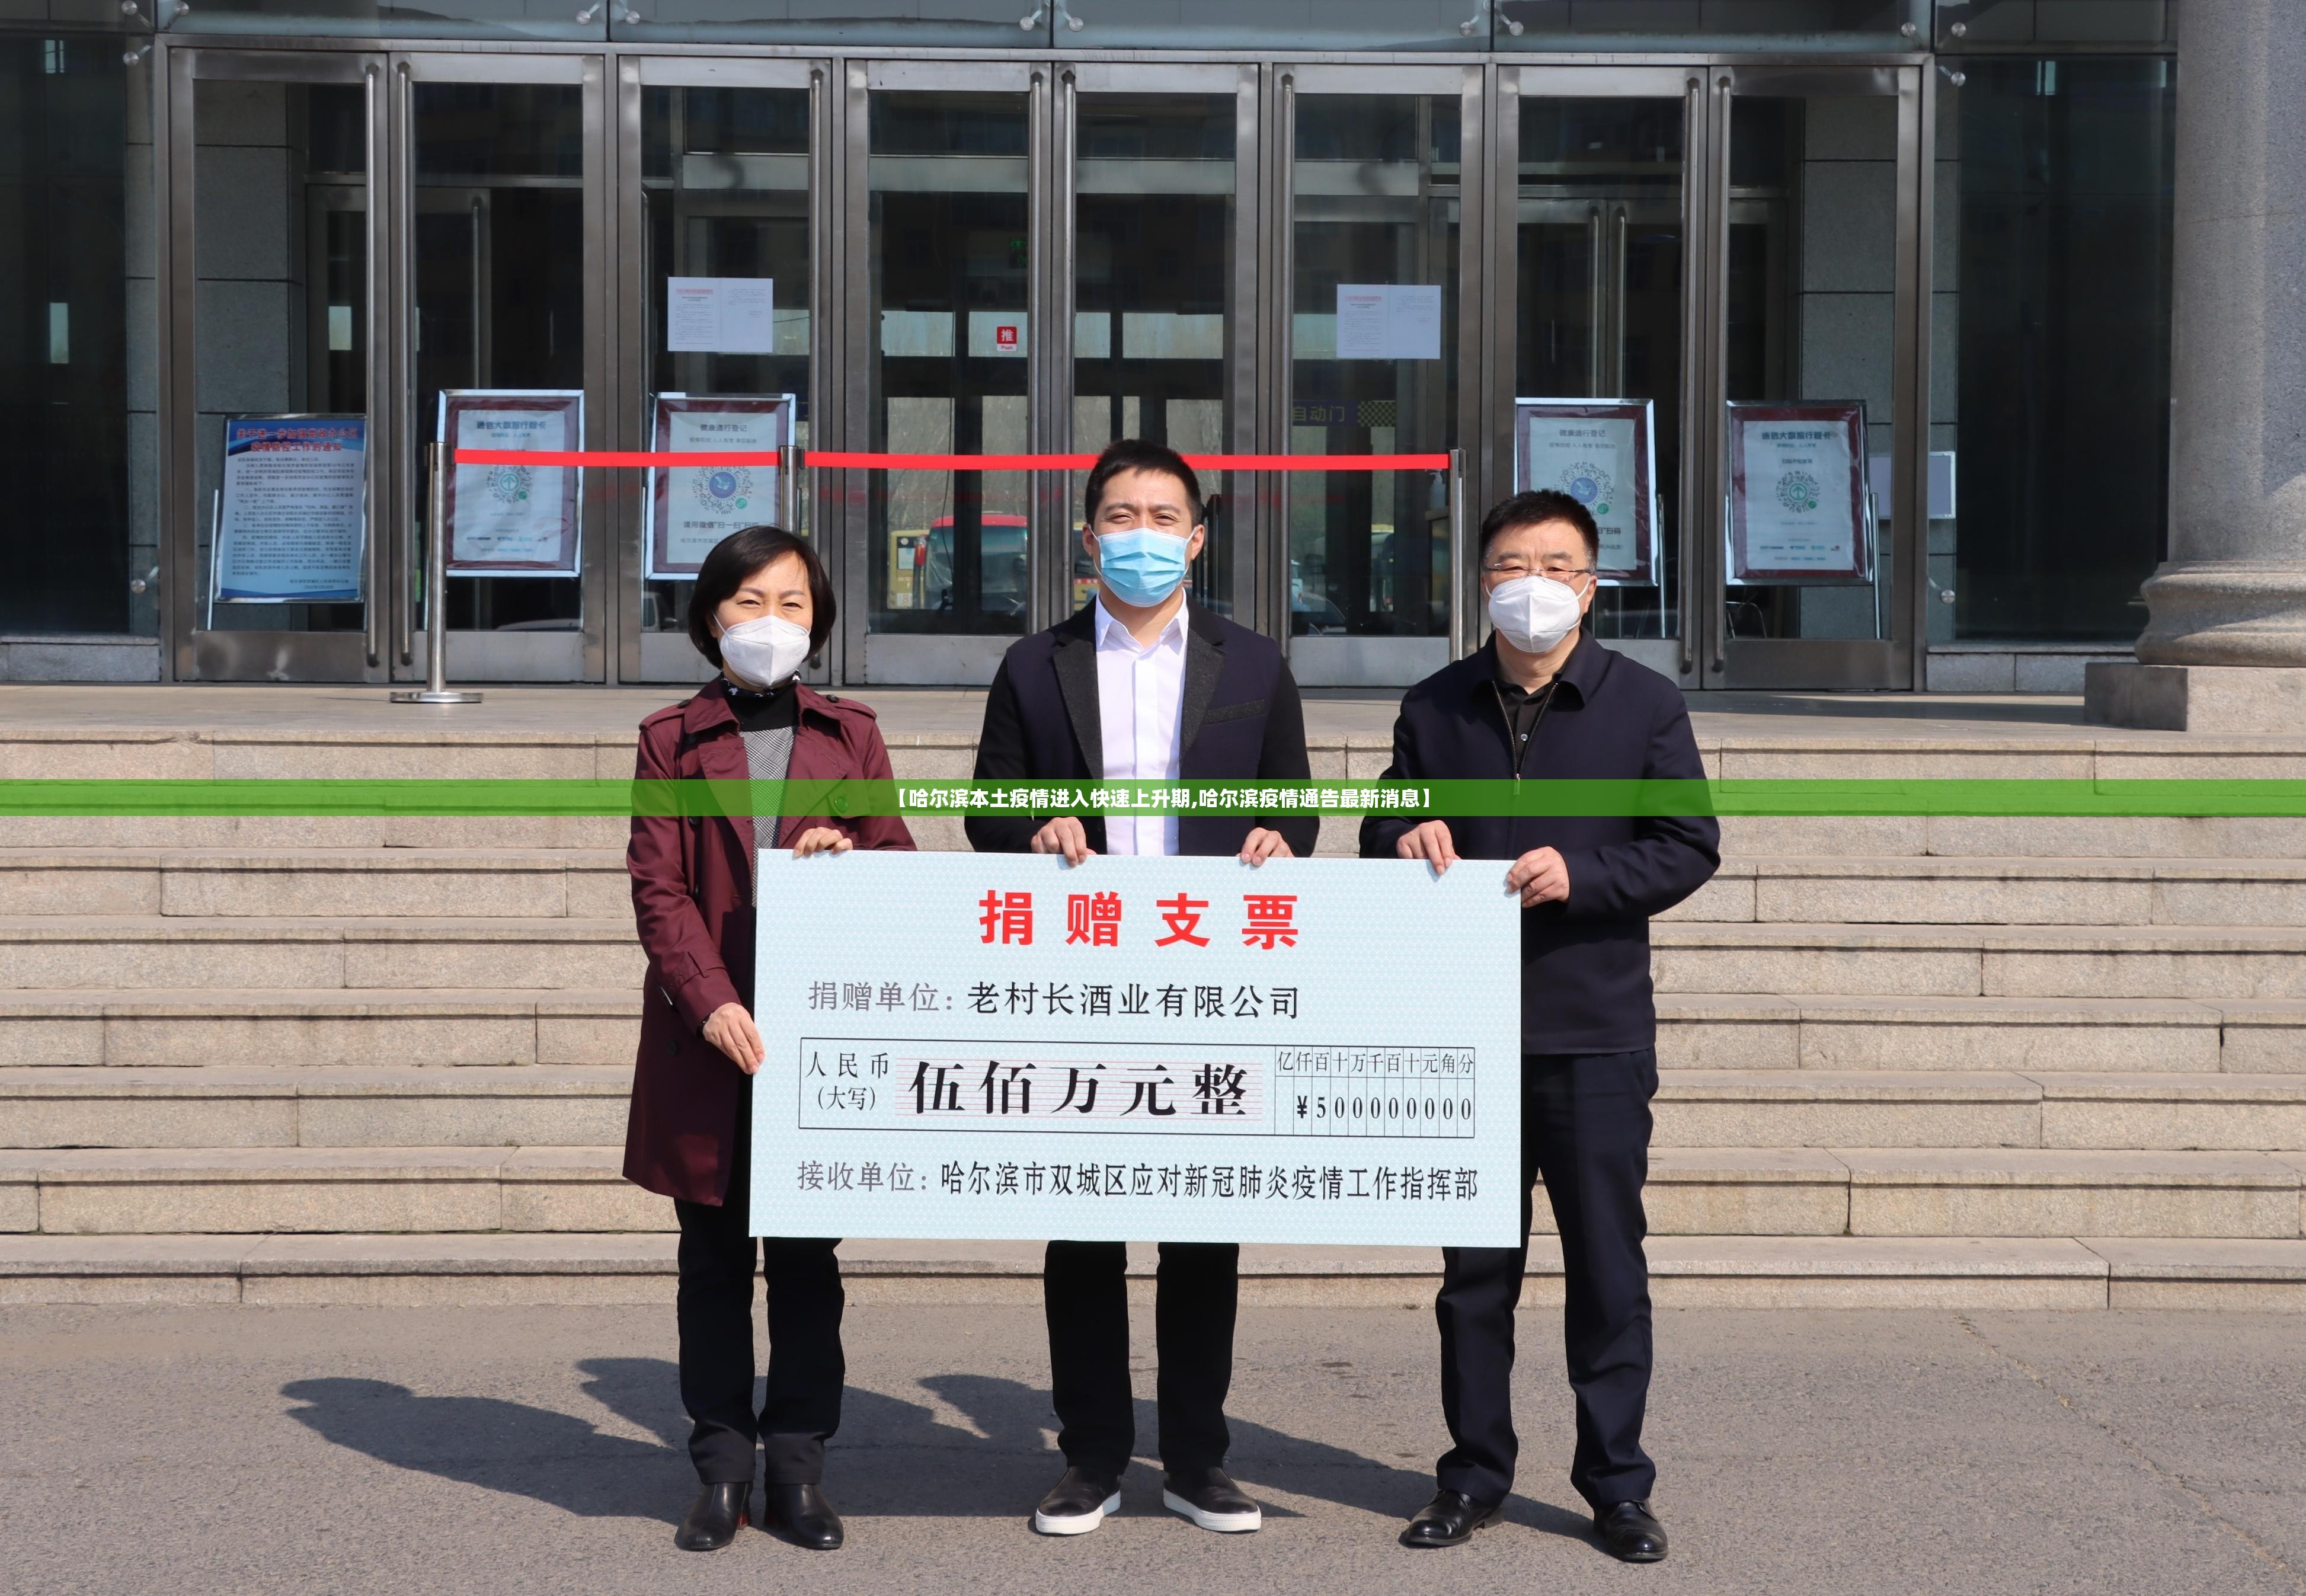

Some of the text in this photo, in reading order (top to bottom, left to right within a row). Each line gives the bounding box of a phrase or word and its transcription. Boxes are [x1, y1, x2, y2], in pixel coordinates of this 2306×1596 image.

[1001, 329, 1013, 341] 推
[1292, 405, 1345, 422] 自动门
[980, 890, 1300, 951] 捐赠支票
[805, 1051, 888, 1079] 人民币
[909, 1060, 1248, 1117] 伍佰万元整
